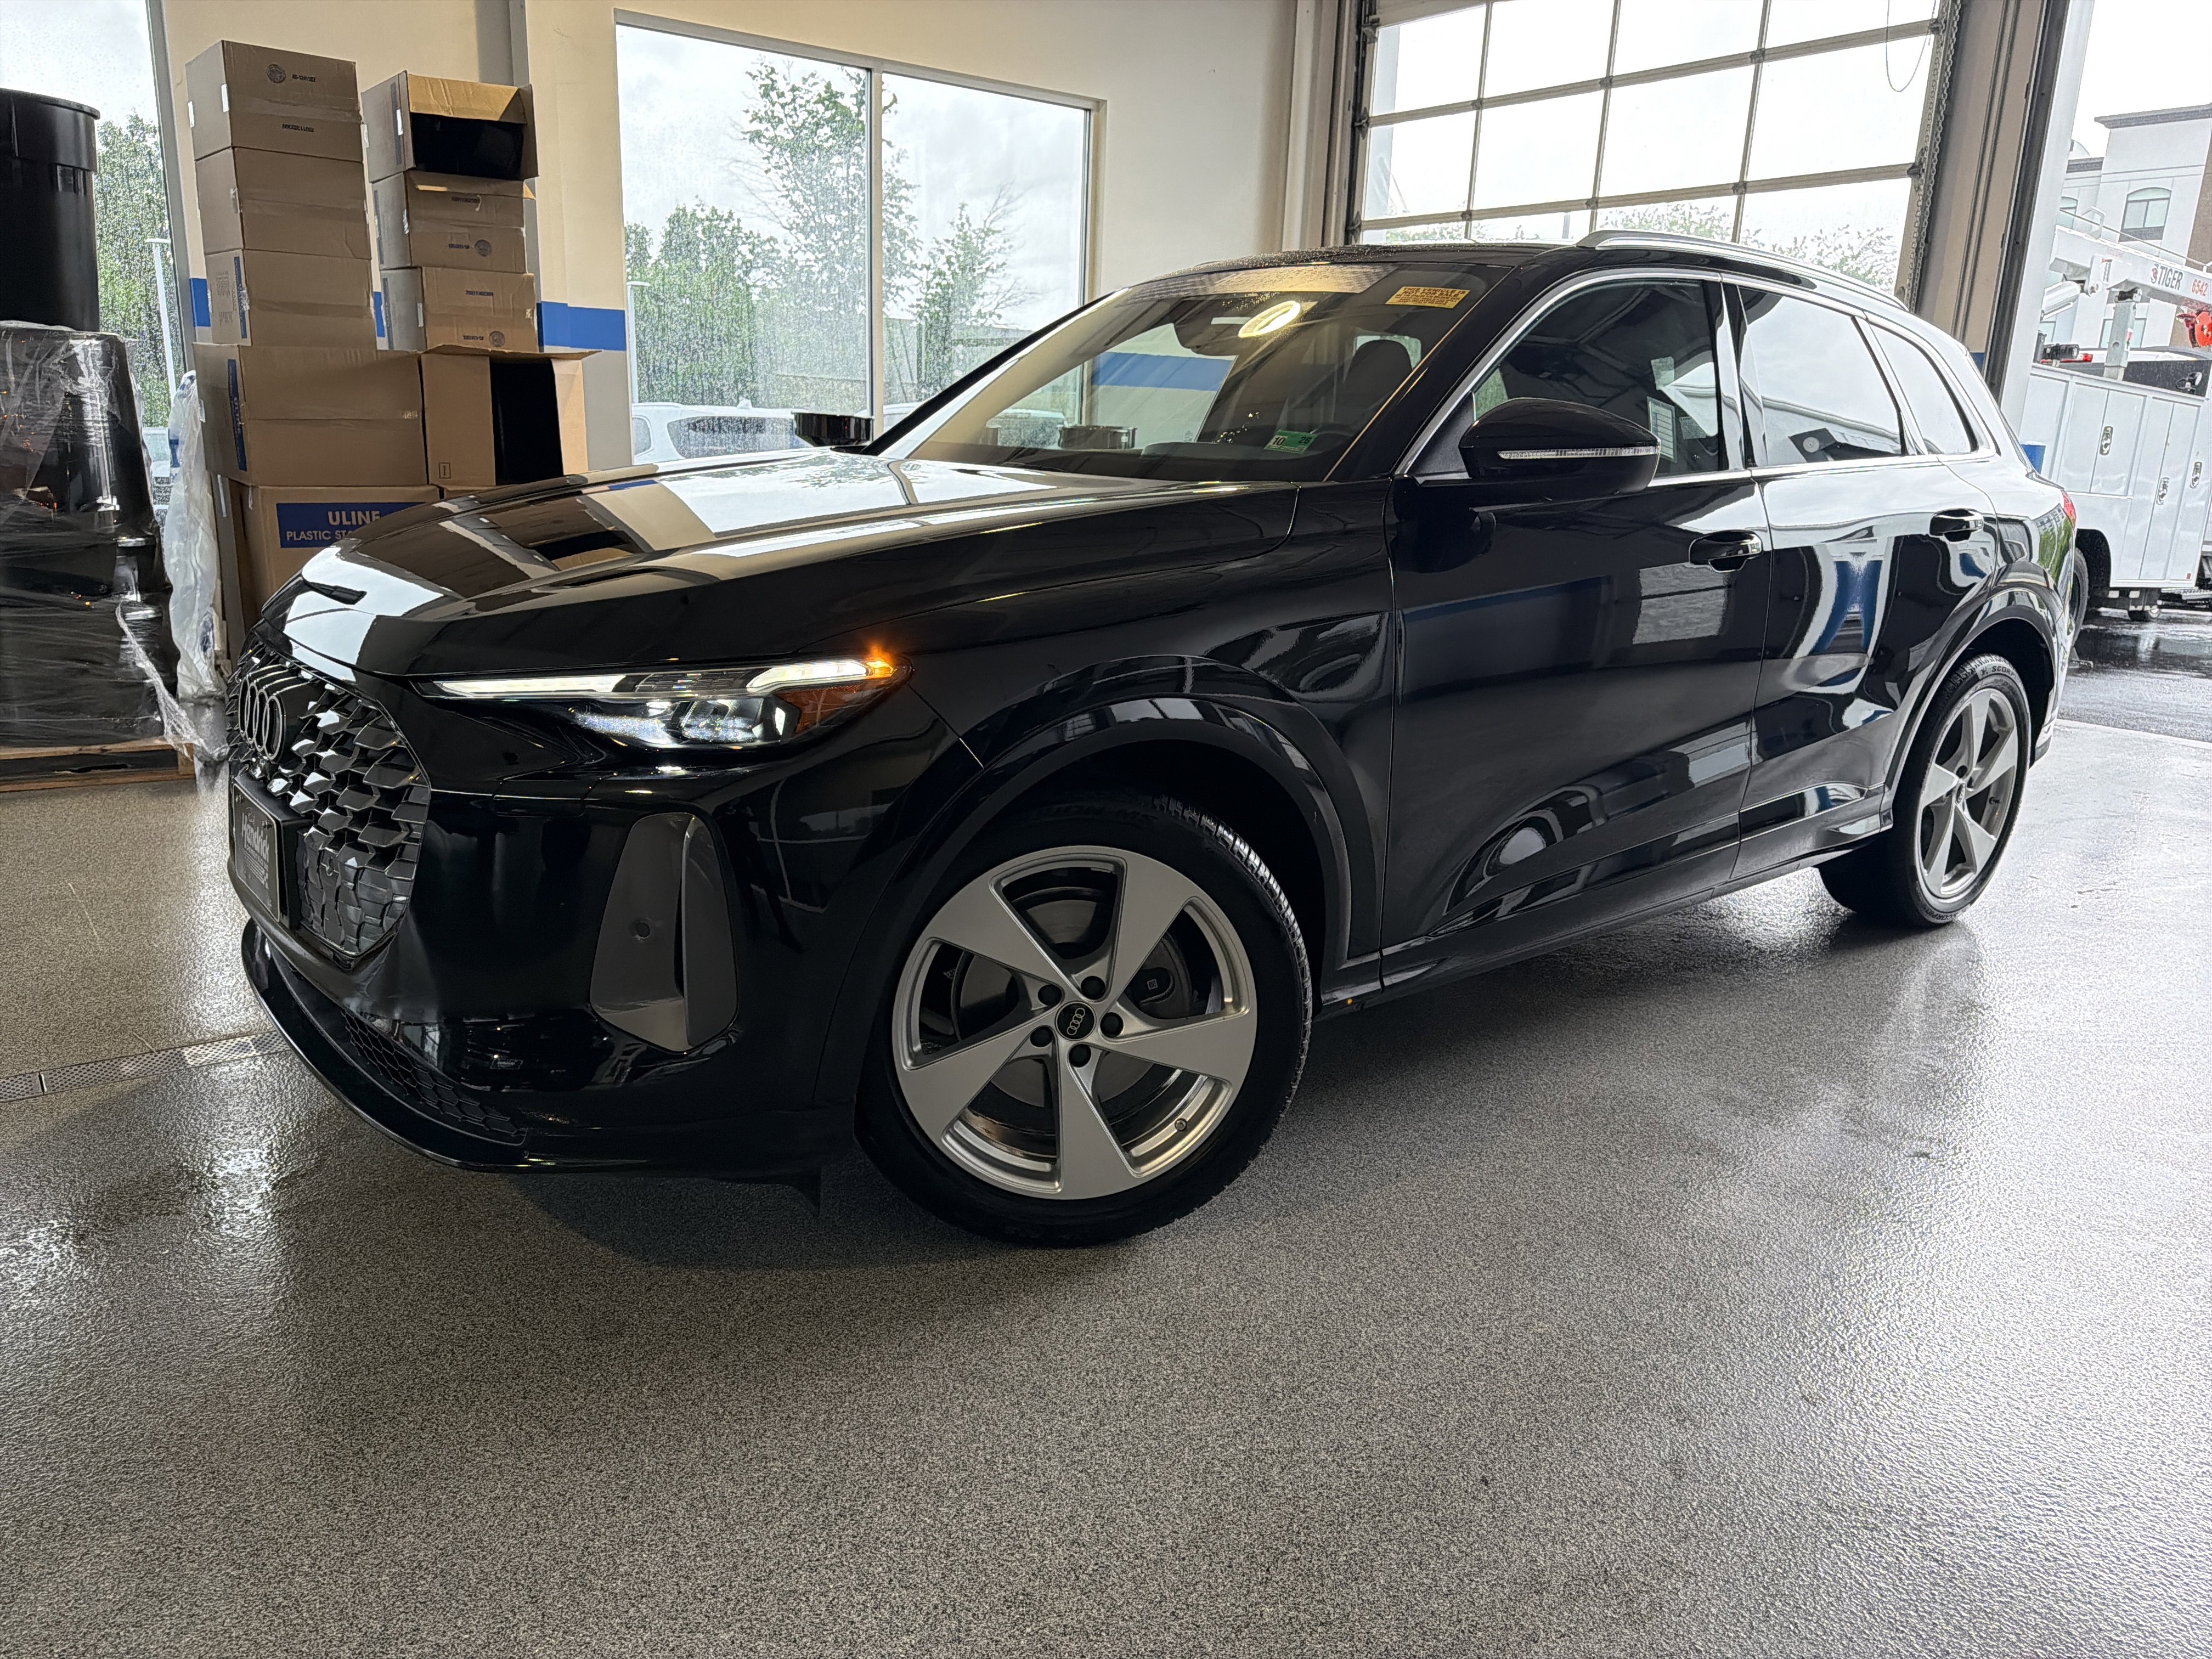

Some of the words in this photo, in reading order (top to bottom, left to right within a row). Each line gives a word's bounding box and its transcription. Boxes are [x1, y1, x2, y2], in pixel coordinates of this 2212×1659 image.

[2158, 266, 2183, 291] TIGER
[2191, 279, 2209, 297] 6542
[1272, 437, 1286, 445] 10
[1298, 436, 1312, 444] 26
[328, 510, 381, 526] ULINE
[286, 530, 331, 541] PLASTIC
[241, 812, 270, 864] Hendrick
